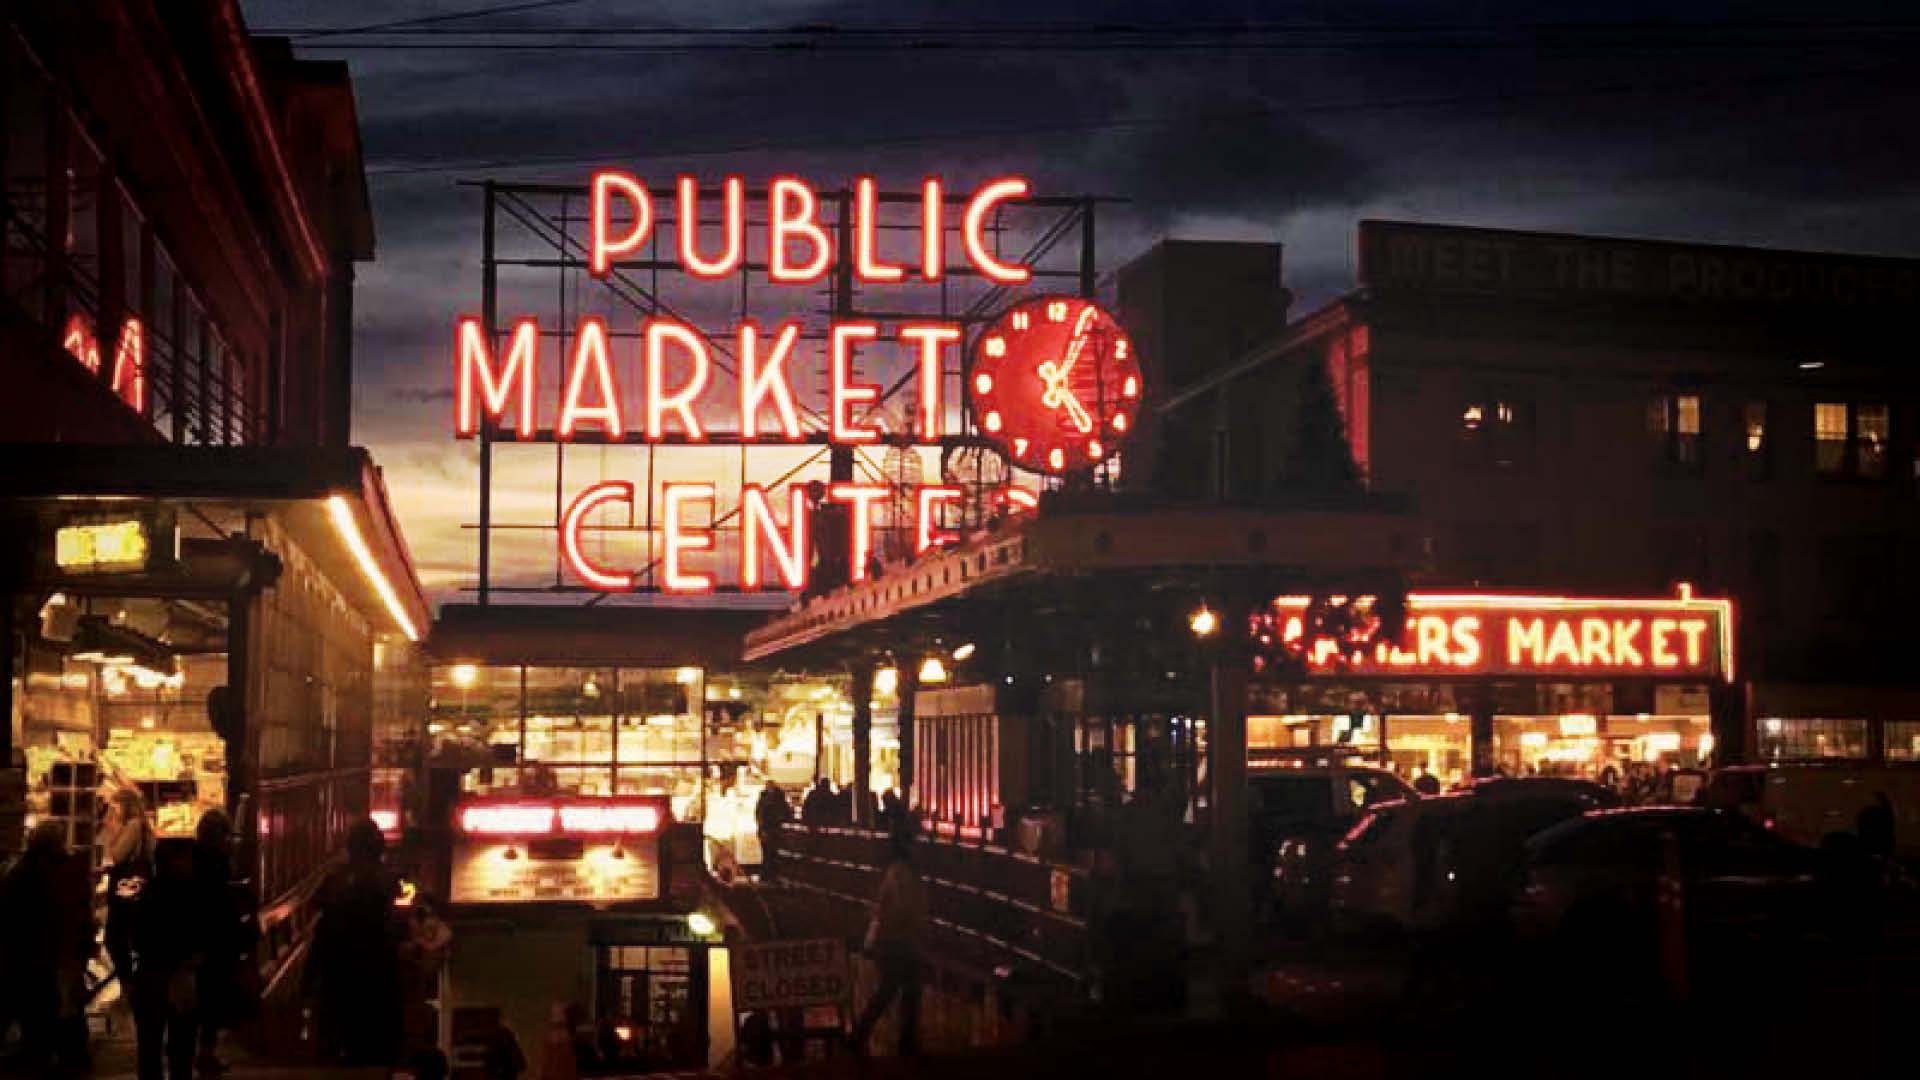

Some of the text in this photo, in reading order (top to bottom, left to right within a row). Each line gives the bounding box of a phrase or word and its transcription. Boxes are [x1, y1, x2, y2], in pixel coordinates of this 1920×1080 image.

[590, 173, 1030, 281] PUBLIC
[1387, 234, 1517, 283] MEET
[1551, 244, 1637, 290] THE
[1012, 312, 1029, 330] 11
[1048, 302, 1067, 322] 12
[1114, 340, 1128, 360] 2
[457, 317, 962, 438] MARKET
[1506, 617, 1706, 667] MARKET
[740, 943, 836, 971] STREET
[743, 974, 842, 1002] CLOSED
